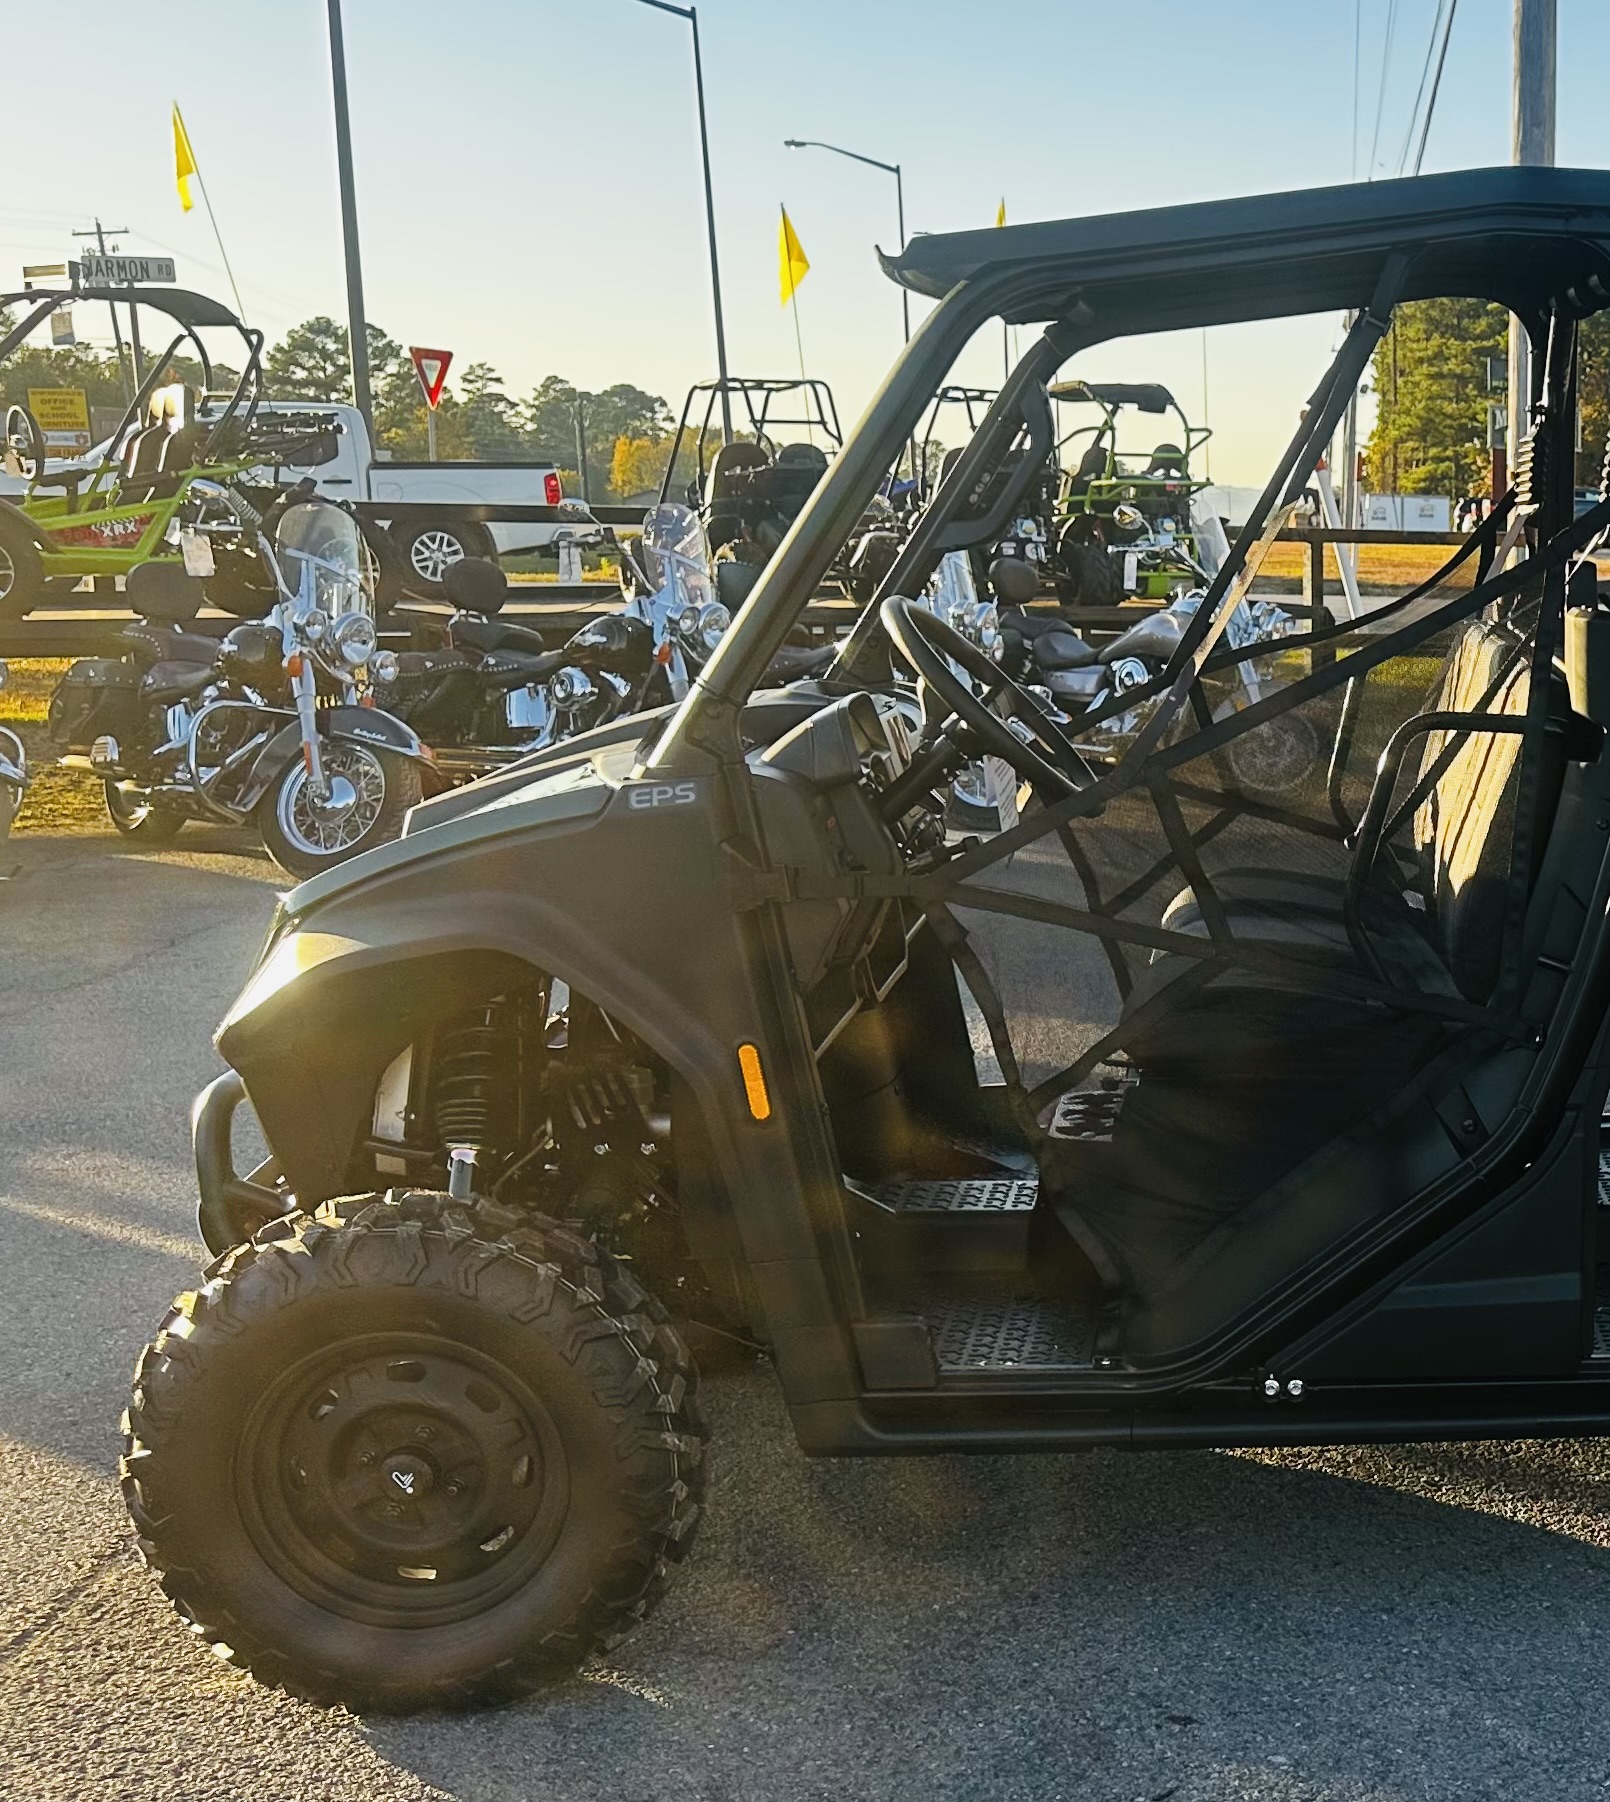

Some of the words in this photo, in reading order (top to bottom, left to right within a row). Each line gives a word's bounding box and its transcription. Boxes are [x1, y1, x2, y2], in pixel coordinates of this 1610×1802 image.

[157, 263, 172, 277] RD
[100, 521, 138, 538] XRX
[630, 782, 696, 809] EPS
